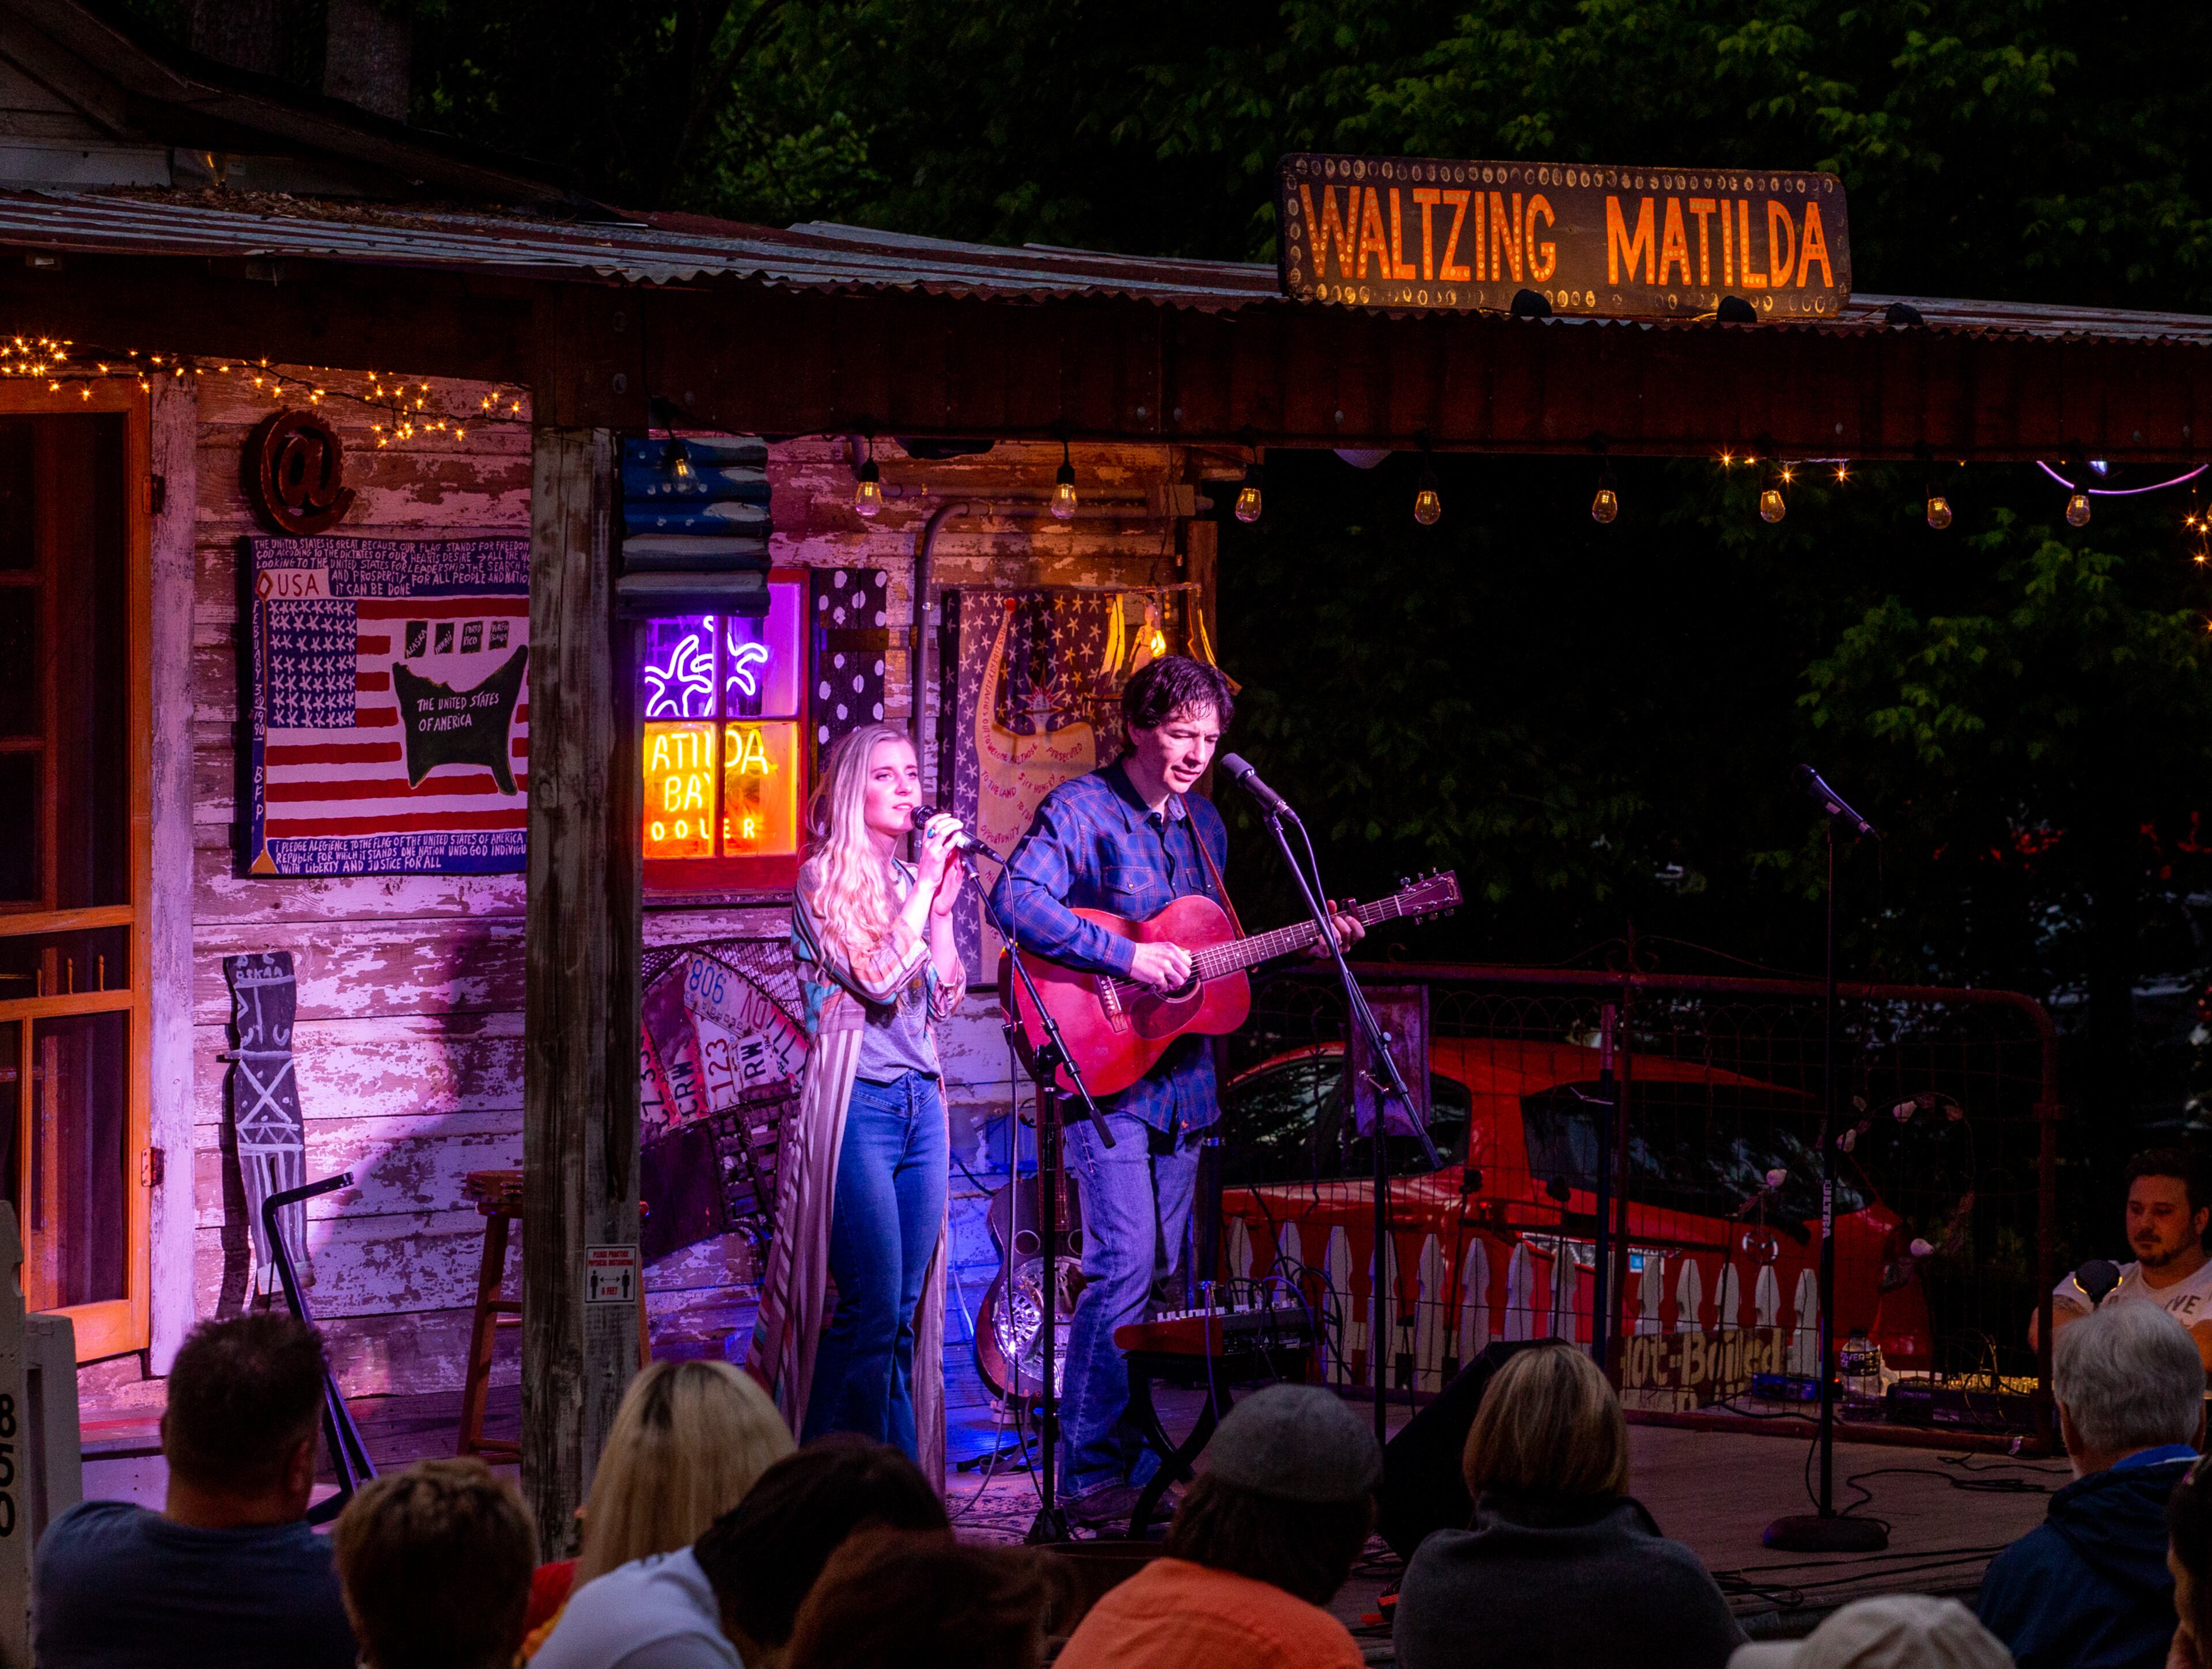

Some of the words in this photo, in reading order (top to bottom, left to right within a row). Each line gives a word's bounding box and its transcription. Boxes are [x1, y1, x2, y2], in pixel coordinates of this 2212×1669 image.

[1299, 184, 1556, 282] WALTZING
[1605, 195, 1834, 288] MATILDA
[255, 540, 269, 550] THE
[300, 538, 325, 549] STATES
[336, 539, 358, 549] GREAT
[362, 540, 396, 551] BECAUSE
[400, 543, 415, 553] OUR
[420, 543, 441, 553] FLAG
[446, 542, 476, 552] STANDS
[479, 541, 494, 551] FOR
[256, 549, 274, 559] GOD
[324, 549, 338, 557] THE
[375, 551, 389, 559] OF
[389, 551, 407, 564] OUR
[411, 553, 441, 563] HEARTS
[487, 551, 502, 561] ALL
[505, 551, 518, 560] THE
[297, 558, 308, 568] TO
[310, 557, 328, 568] THE
[360, 560, 389, 570] STATES
[391, 560, 407, 572] FOR
[468, 563, 484, 572] THE
[488, 560, 520, 572] SEARCH
[278, 573, 319, 597] USA
[331, 570, 349, 582] AND
[412, 574, 430, 587] FOR
[432, 572, 450, 585] ALL
[453, 572, 486, 585] PEOPLE
[487, 572, 503, 583] AND
[347, 583, 367, 595] CAN
[370, 583, 383, 595] BE
[388, 583, 411, 595] DONE
[406, 629, 427, 658] ALASKA
[417, 697, 434, 712] THE
[469, 690, 499, 707] STATES
[419, 718, 433, 731] OF
[1046, 742, 1083, 763] PERSECUTED
[999, 787, 1017, 799] LAND
[281, 840, 307, 852] PLEDGE
[350, 840, 358, 851] TO
[359, 838, 372, 849] THE
[373, 837, 392, 849] FLAG
[393, 836, 406, 848] OF
[406, 836, 421, 847] THE
[450, 834, 477, 845] STATES
[479, 834, 490, 844] OF
[317, 852, 333, 863] FOR
[368, 847, 397, 860] STANDS
[401, 846, 415, 857] ONE
[448, 845, 468, 856] UNTO
[469, 845, 487, 856] GOD
[342, 860, 363, 872] AND
[404, 856, 422, 870] FOR
[423, 856, 442, 870] ALL
[705, 1038, 734, 1093] 123
[1822, 1184, 1832, 1239] ULTRA
